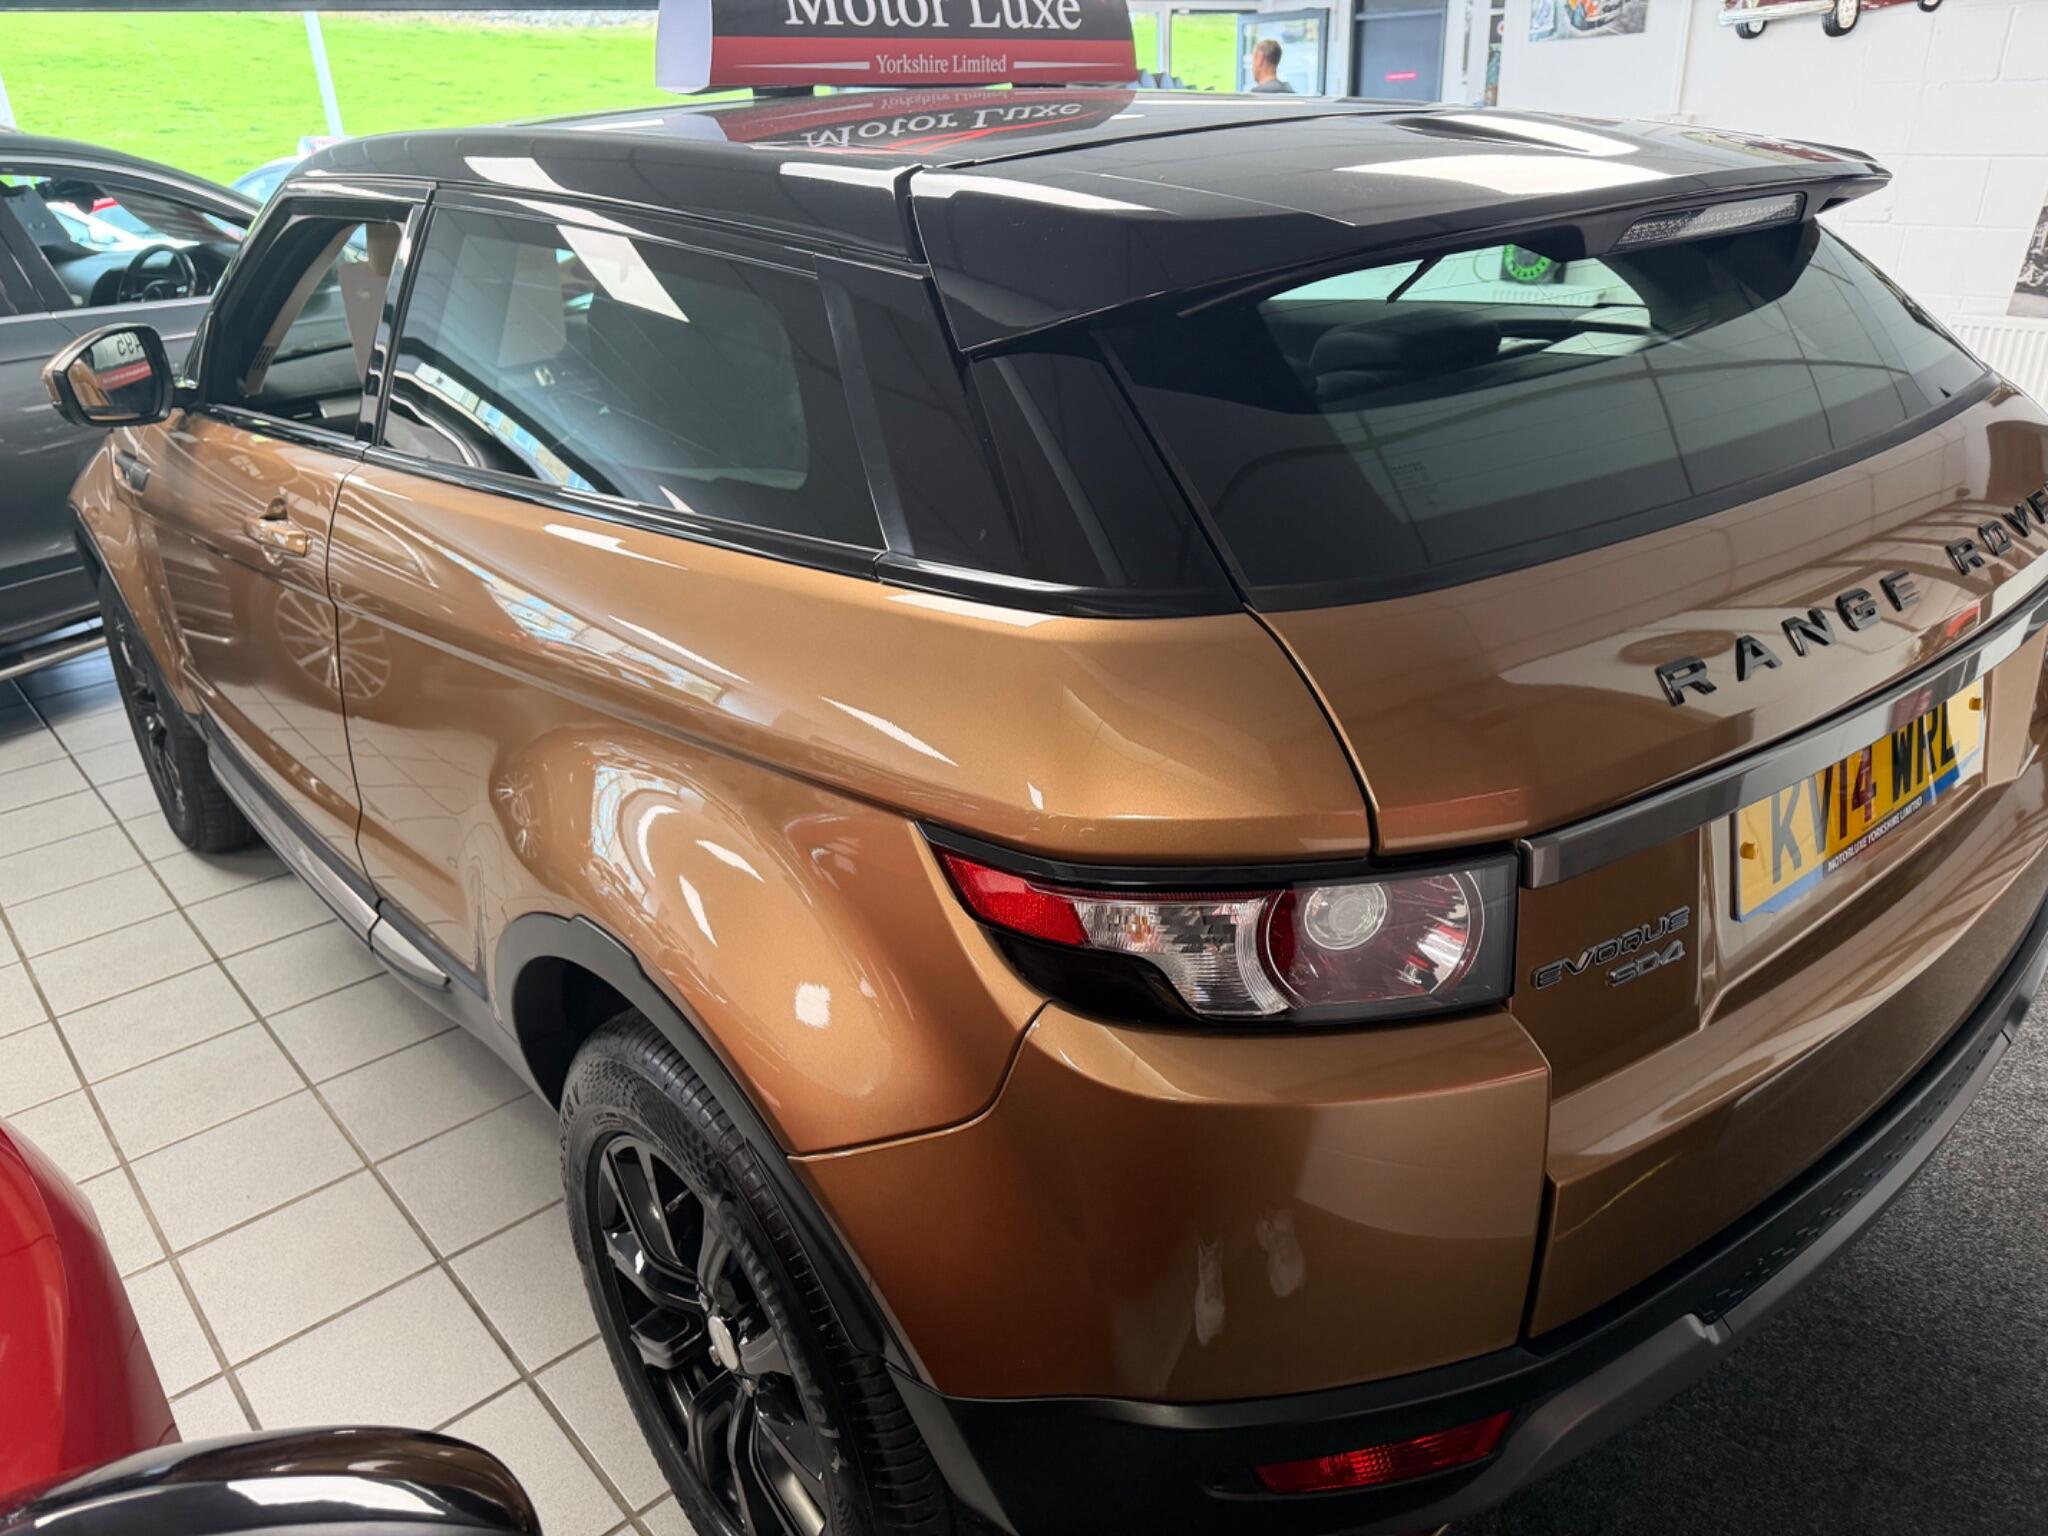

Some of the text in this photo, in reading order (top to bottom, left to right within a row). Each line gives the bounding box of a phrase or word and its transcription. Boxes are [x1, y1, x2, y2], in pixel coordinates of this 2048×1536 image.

[785, 0, 1082, 30] Motor Luxe
[876, 54, 1007, 73] Yorkshire Limited
[1654, 482, 2048, 707] RANGE ROVE
[1770, 700, 1957, 885] KV14 WRL
[1531, 905, 1690, 990] EVOQUE
[1605, 938, 1687, 988] SD4
